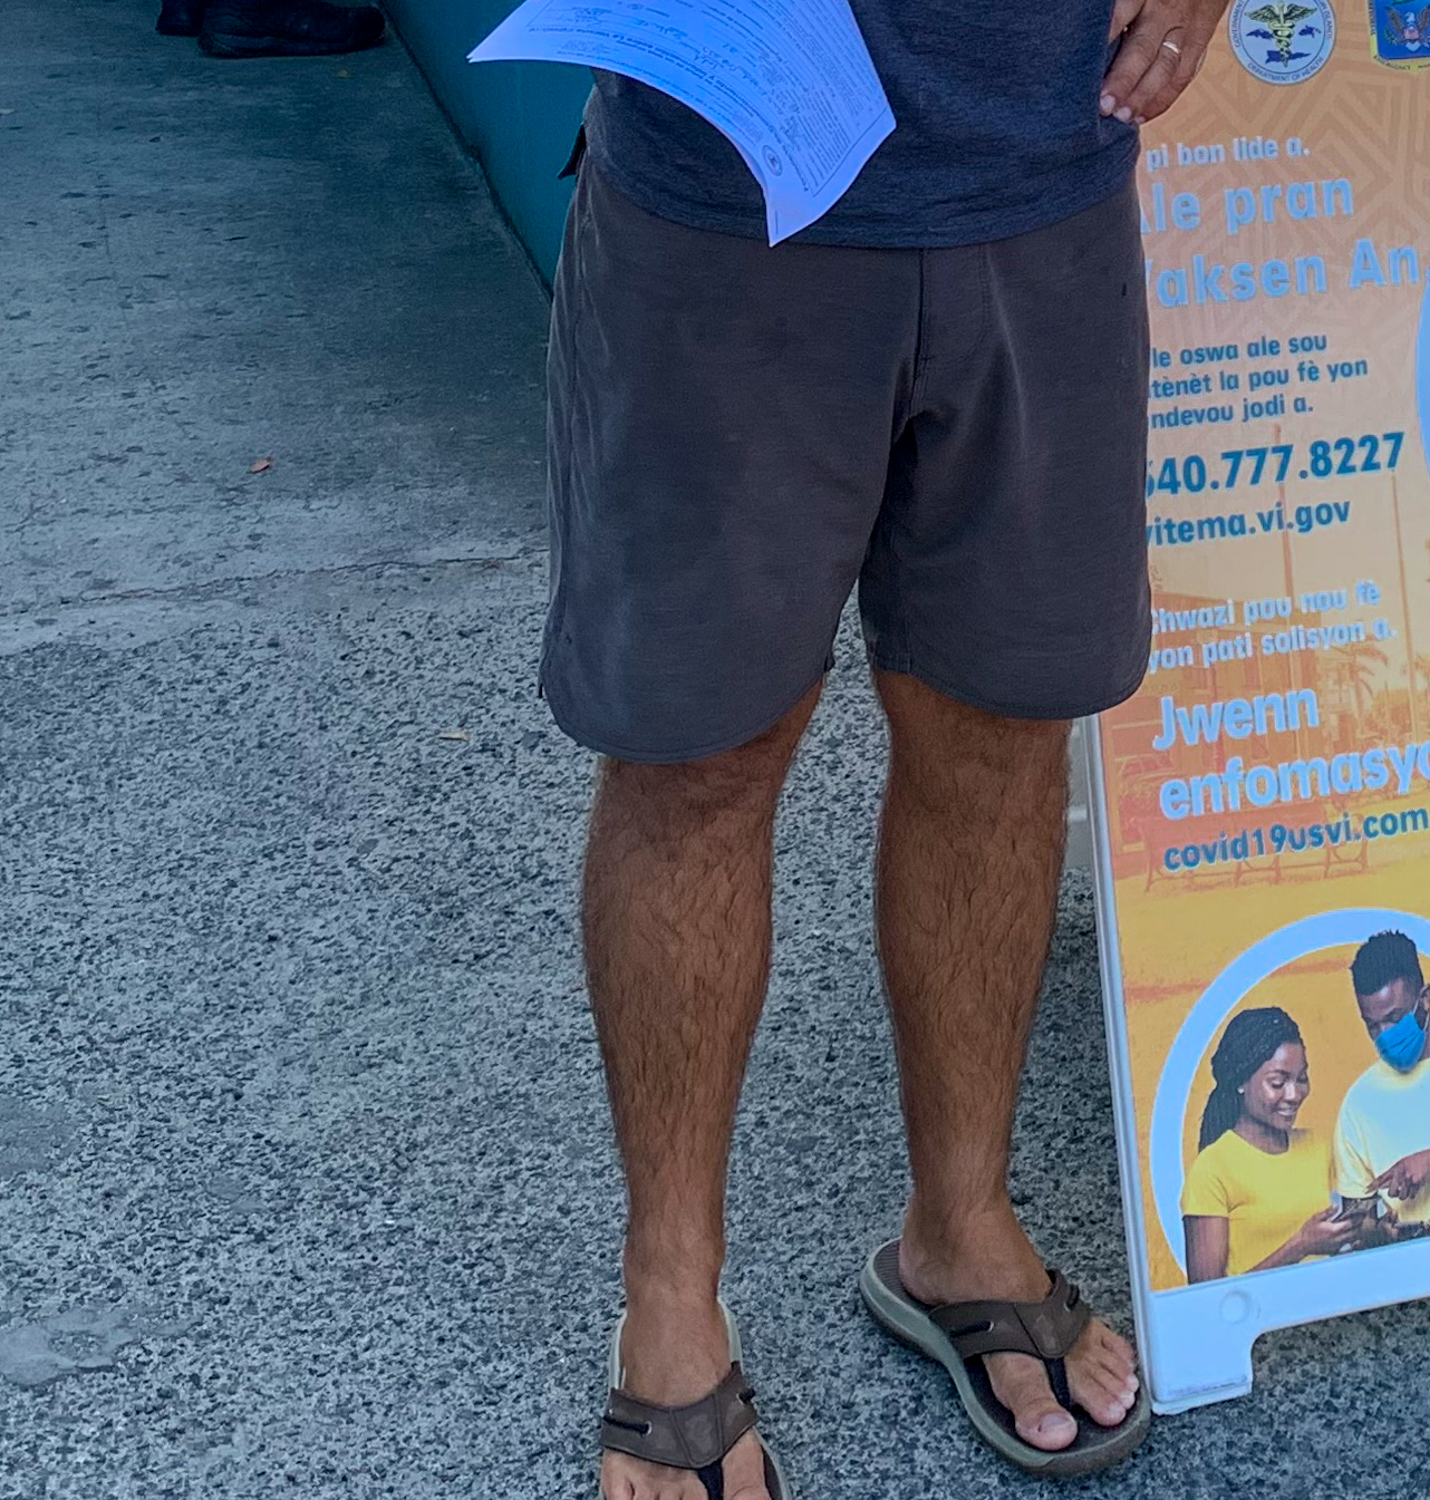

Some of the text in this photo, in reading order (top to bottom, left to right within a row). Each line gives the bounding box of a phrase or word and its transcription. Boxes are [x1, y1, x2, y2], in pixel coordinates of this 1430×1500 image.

[1146, 135, 1310, 173] pi bon lide a.
[1141, 176, 1354, 235] le pran
[1145, 253, 1327, 310] aksen
[1179, 344, 1239, 366] oswa
[1247, 336, 1281, 358] ale
[1288, 334, 1328, 354] sou
[1151, 359, 1369, 399] tènèt la pou fè yon
[1149, 393, 1314, 429] ndevou jodi a.
[1243, 597, 1292, 627] pou
[1300, 589, 1347, 614] nou
[1202, 632, 1253, 669] pati
[1152, 688, 1320, 751] Jwenn
[1163, 805, 1430, 872] covid19usvi.com
